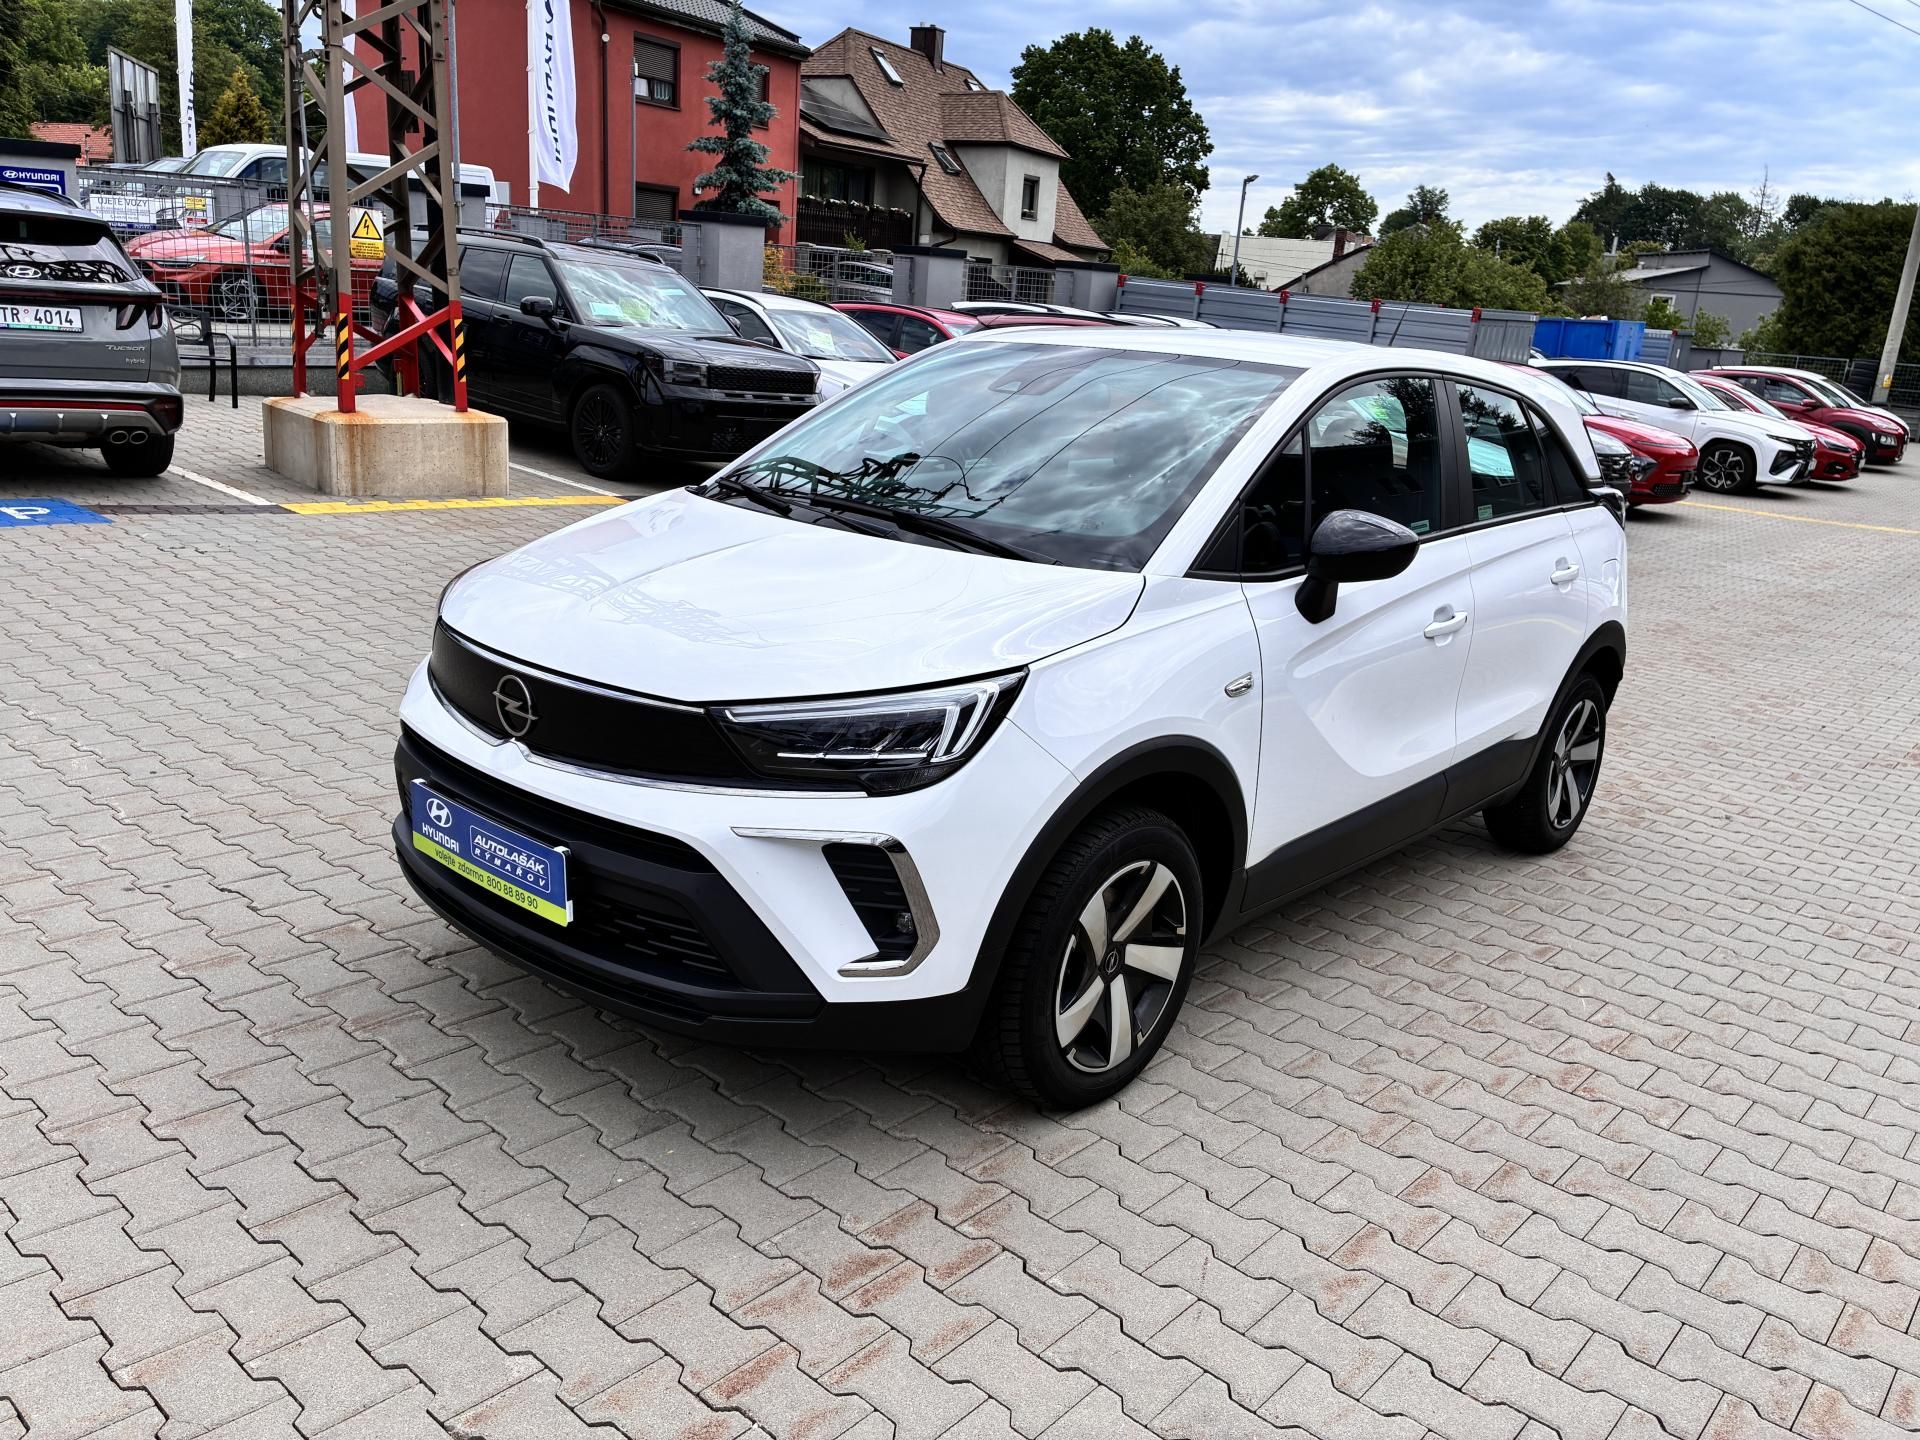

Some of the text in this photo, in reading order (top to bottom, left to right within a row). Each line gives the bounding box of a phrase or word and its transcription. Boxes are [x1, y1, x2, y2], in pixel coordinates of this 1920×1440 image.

[19, 171, 60, 182] HYUNDAI
[125, 199, 148, 208] VOZY
[34, 308, 74, 326] 4014
[125, 357, 145, 366] hybrid
[421, 822, 460, 854] HYUNDAI
[473, 834, 545, 876] AUTOLAŠÁK
[474, 847, 546, 887] RÝMAŘOV
[434, 847, 538, 910] volejte zdarma 800 88 89 90
